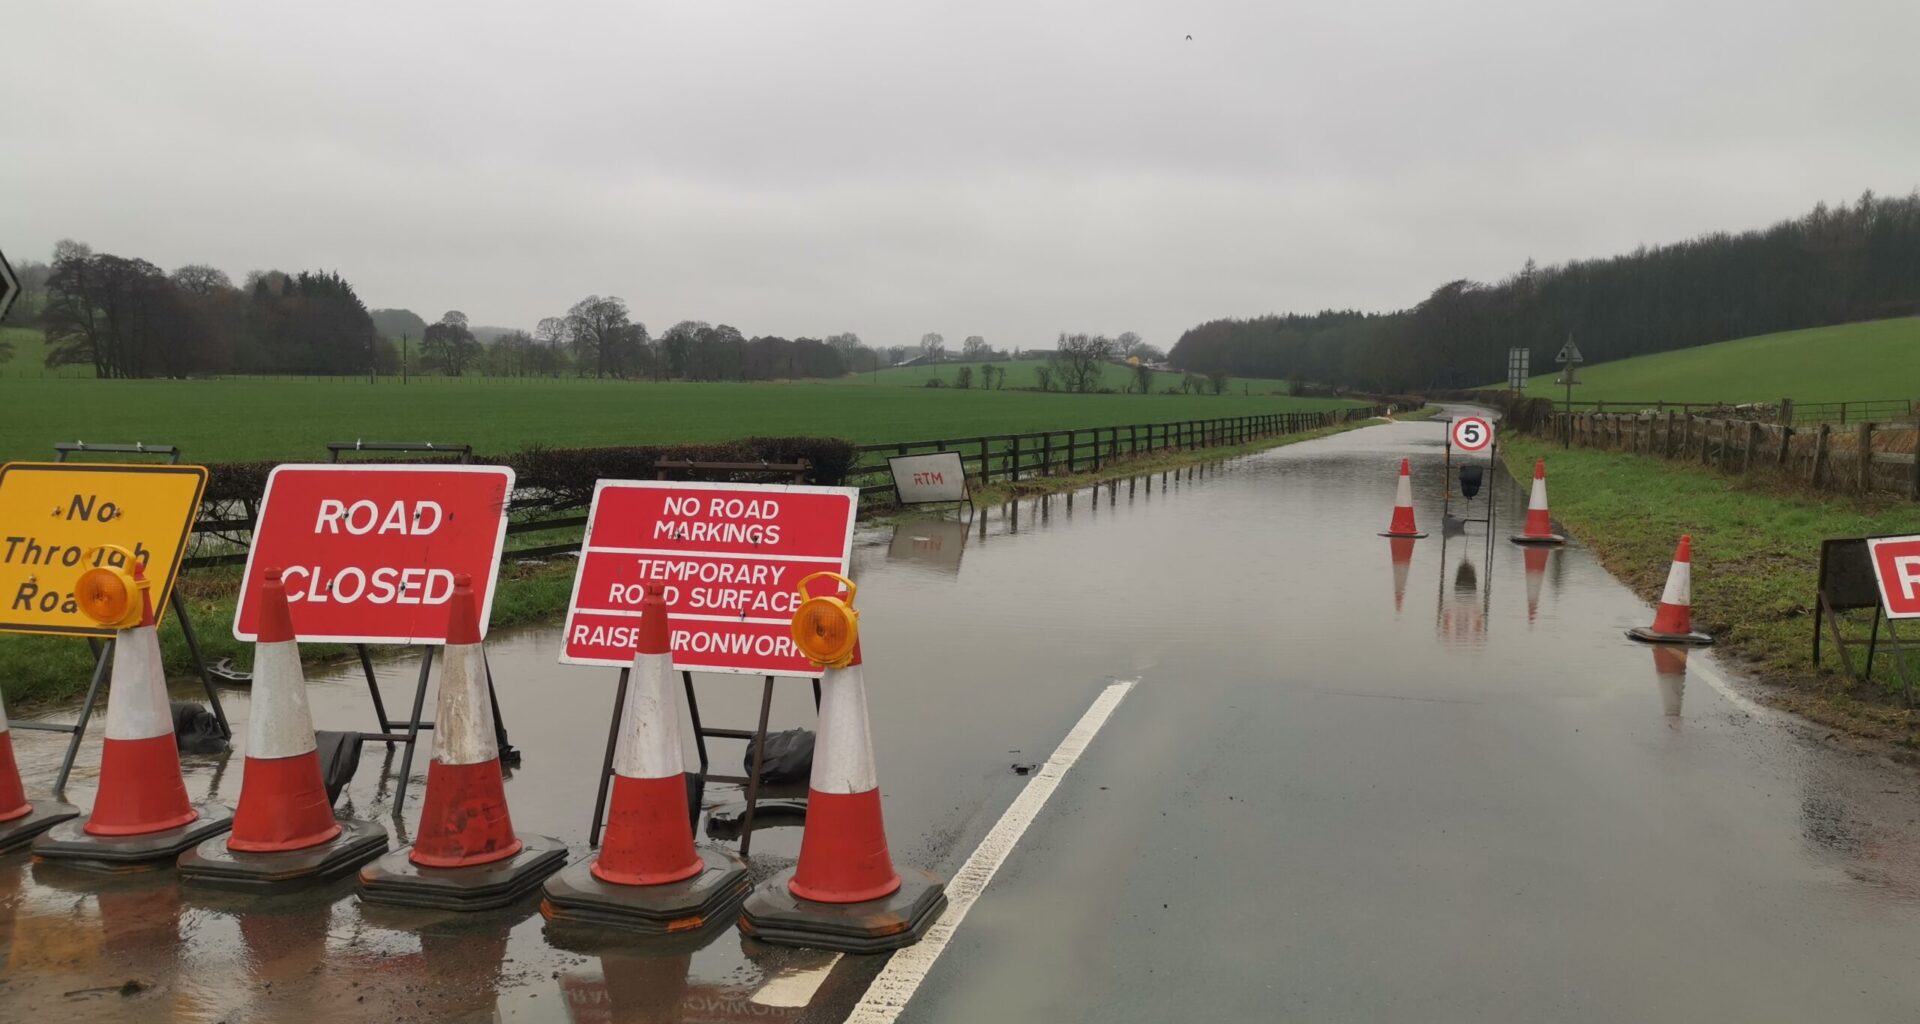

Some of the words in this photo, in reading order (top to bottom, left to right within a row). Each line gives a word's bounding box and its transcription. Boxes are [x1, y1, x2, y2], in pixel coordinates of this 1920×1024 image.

[1464, 424, 1480, 444] 5
[913, 471, 944, 486] RTM
[66, 494, 116, 523] No
[314, 499, 443, 536] ROAD
[663, 496, 700, 517] NO
[709, 498, 780, 520] ROAD
[653, 520, 781, 545] MARKINGS
[280, 565, 455, 605] CLOSED
[637, 559, 786, 586] TEMPORARY
[12, 582, 78, 614] Roa
[608, 583, 679, 606] ROD
[689, 587, 802, 612] SURFACE
[573, 624, 640, 648] RAISE
